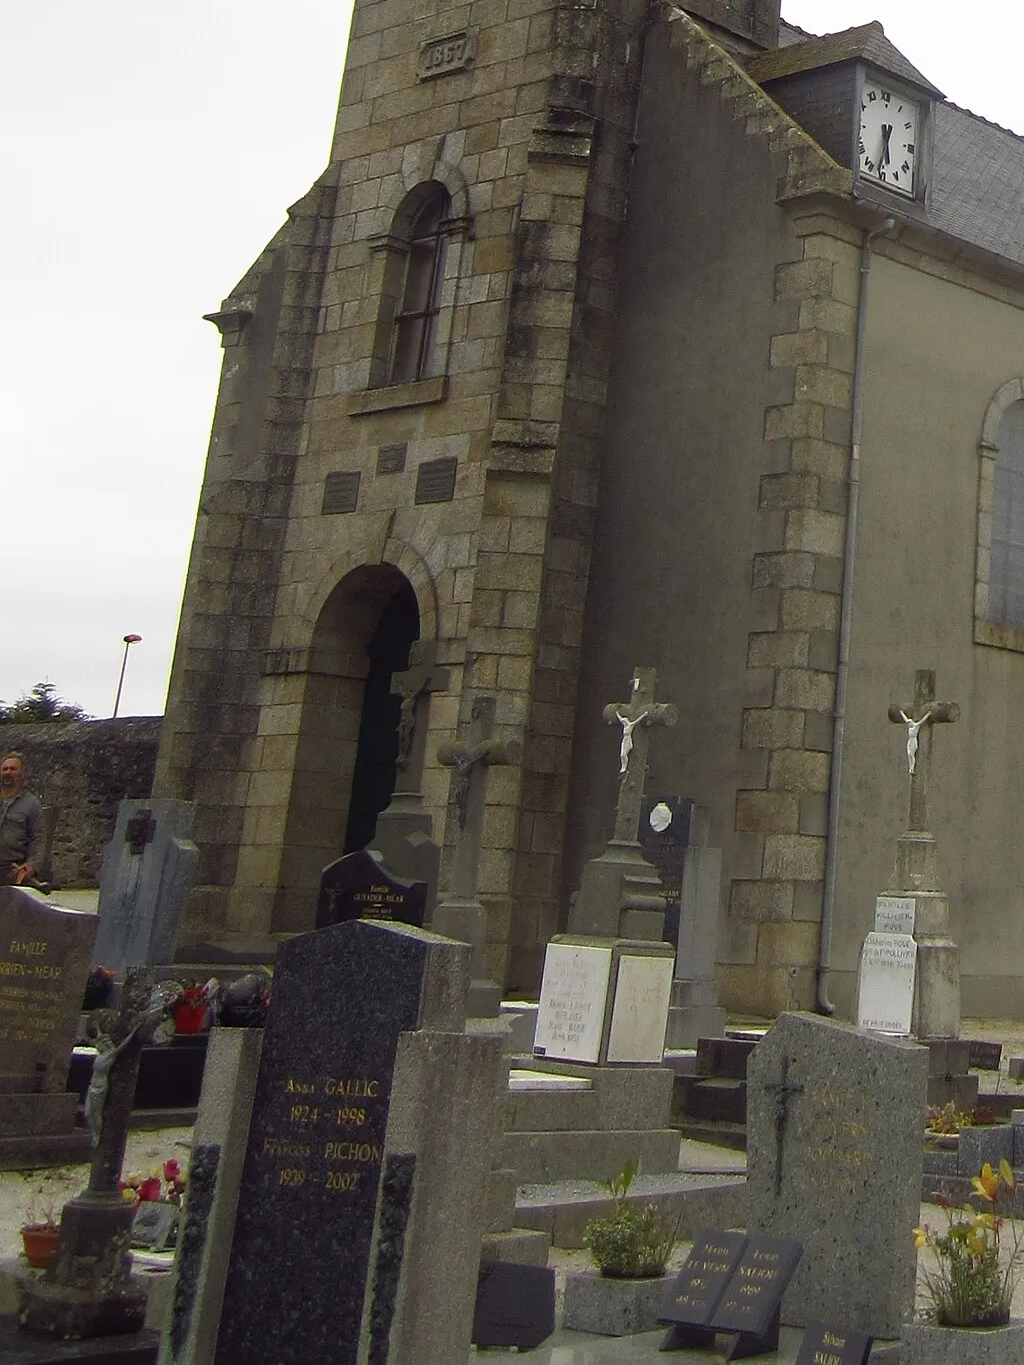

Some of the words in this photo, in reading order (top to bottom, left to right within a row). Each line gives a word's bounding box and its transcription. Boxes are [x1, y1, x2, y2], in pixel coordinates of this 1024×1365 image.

[10, 940, 47, 954] FAMILLE
[324, 1078, 379, 1098] GALLIC
[290, 1105, 319, 1123] 1924
[337, 1107, 365, 1126] 1998
[324, 1141, 381, 1163] PICHON
[279, 1169, 305, 1187] 1939
[325, 1171, 359, 1191] 2002
